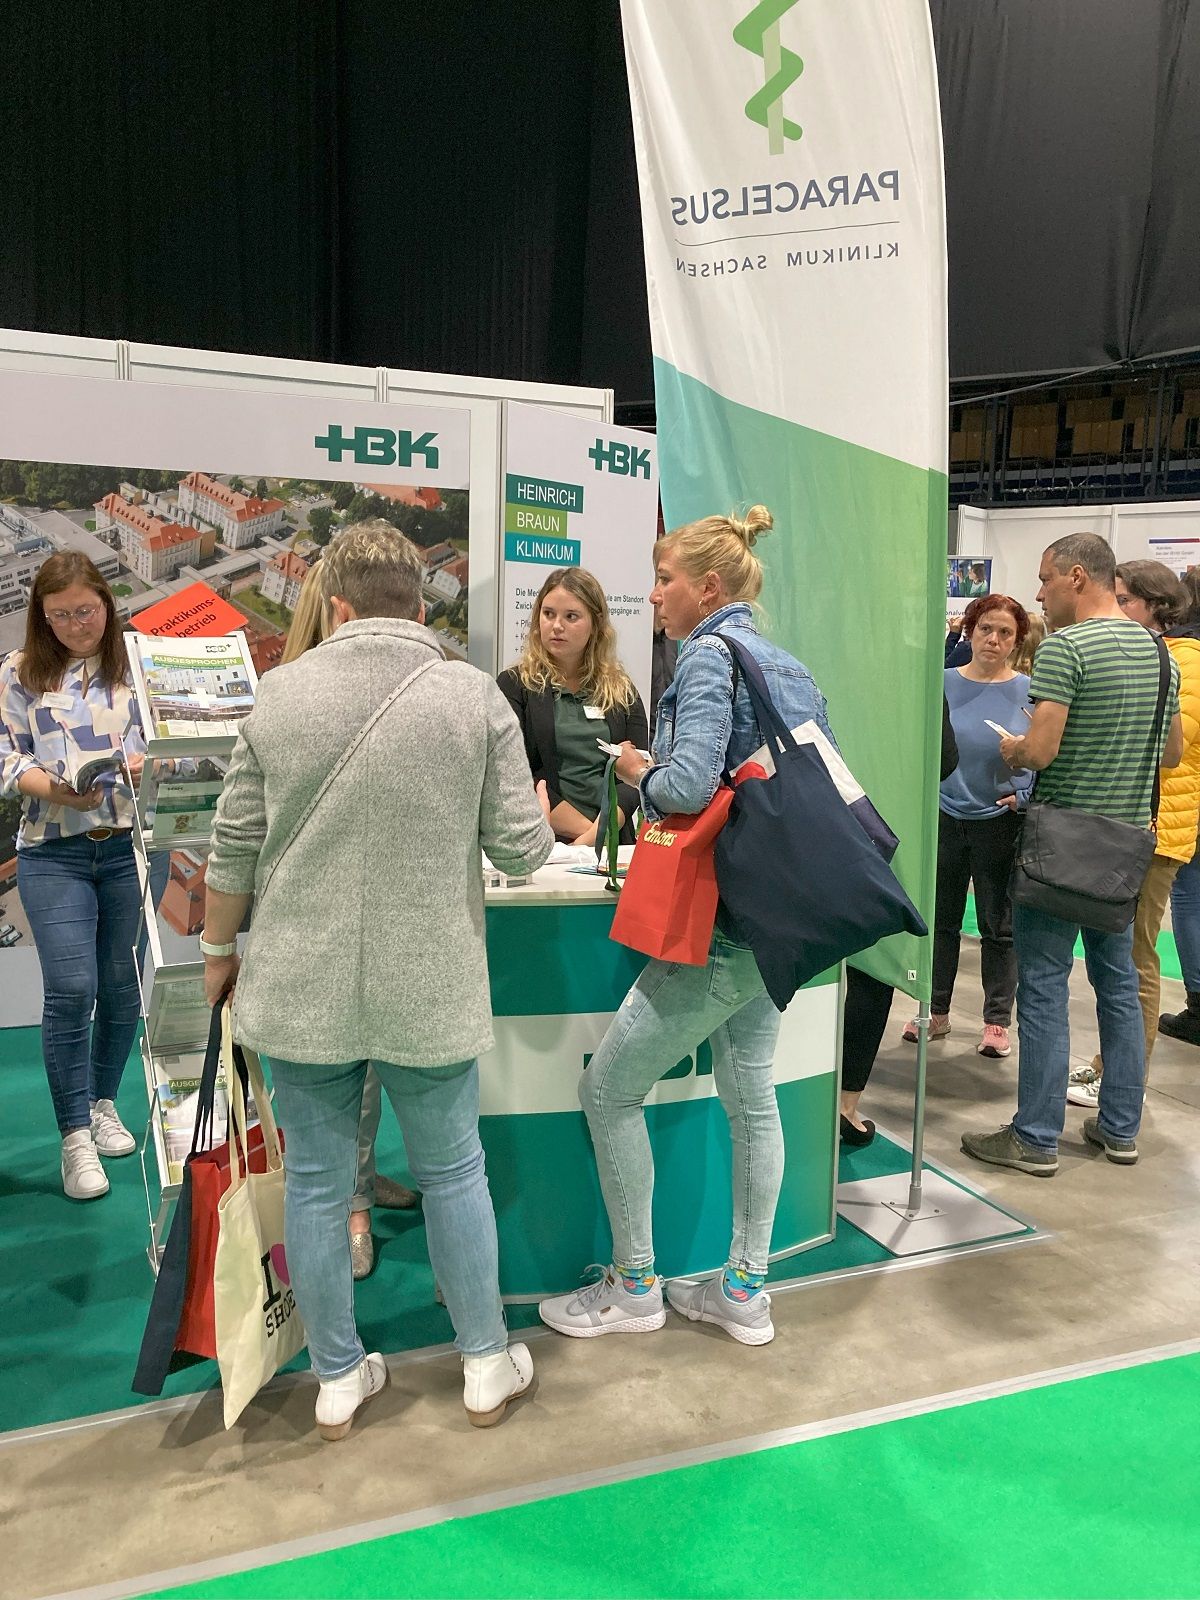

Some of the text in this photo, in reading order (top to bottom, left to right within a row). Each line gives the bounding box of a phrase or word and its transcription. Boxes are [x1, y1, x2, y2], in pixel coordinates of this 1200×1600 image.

[517, 482, 576, 507] HEINRICH
[517, 511, 560, 532] BRAUN
[516, 540, 574, 561] KLINIKUM
[515, 588, 526, 596] Die
[623, 594, 644, 603] Standort
[150, 598, 215, 636] Praktikums-
[175, 614, 216, 638] betrieb
[153, 655, 238, 665] AUSGESPROCHEN
[261, 1250, 281, 1313] I
